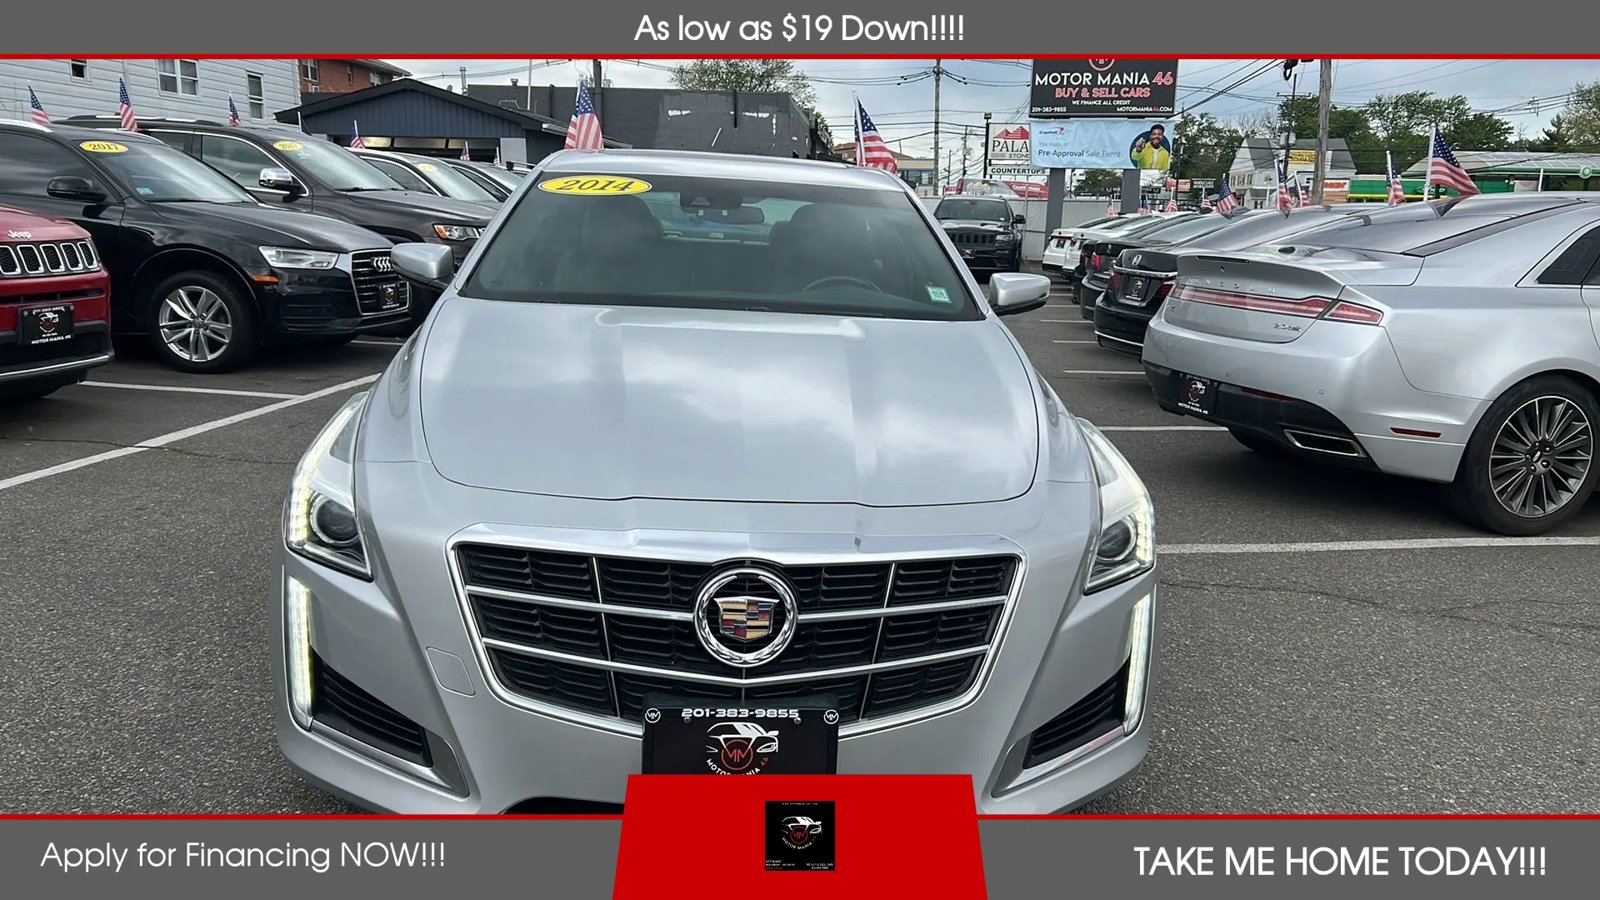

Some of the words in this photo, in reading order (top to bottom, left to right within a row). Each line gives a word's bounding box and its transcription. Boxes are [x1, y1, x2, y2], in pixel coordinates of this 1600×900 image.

[1035, 73, 1092, 85] MOTOR
[1098, 73, 1150, 85] MANIA
[1153, 72, 1173, 85] 46
[1055, 88, 1079, 98] BUY
[1081, 88, 1089, 98] &
[1092, 88, 1118, 98] SELL
[1121, 88, 1150, 98] CARS
[992, 140, 1029, 152] PALA
[1038, 150, 1085, 158] Pre-Approval
[556, 180, 635, 192] 2014
[8, 230, 32, 239] Jeep
[681, 708, 799, 718] 201-383-9855
